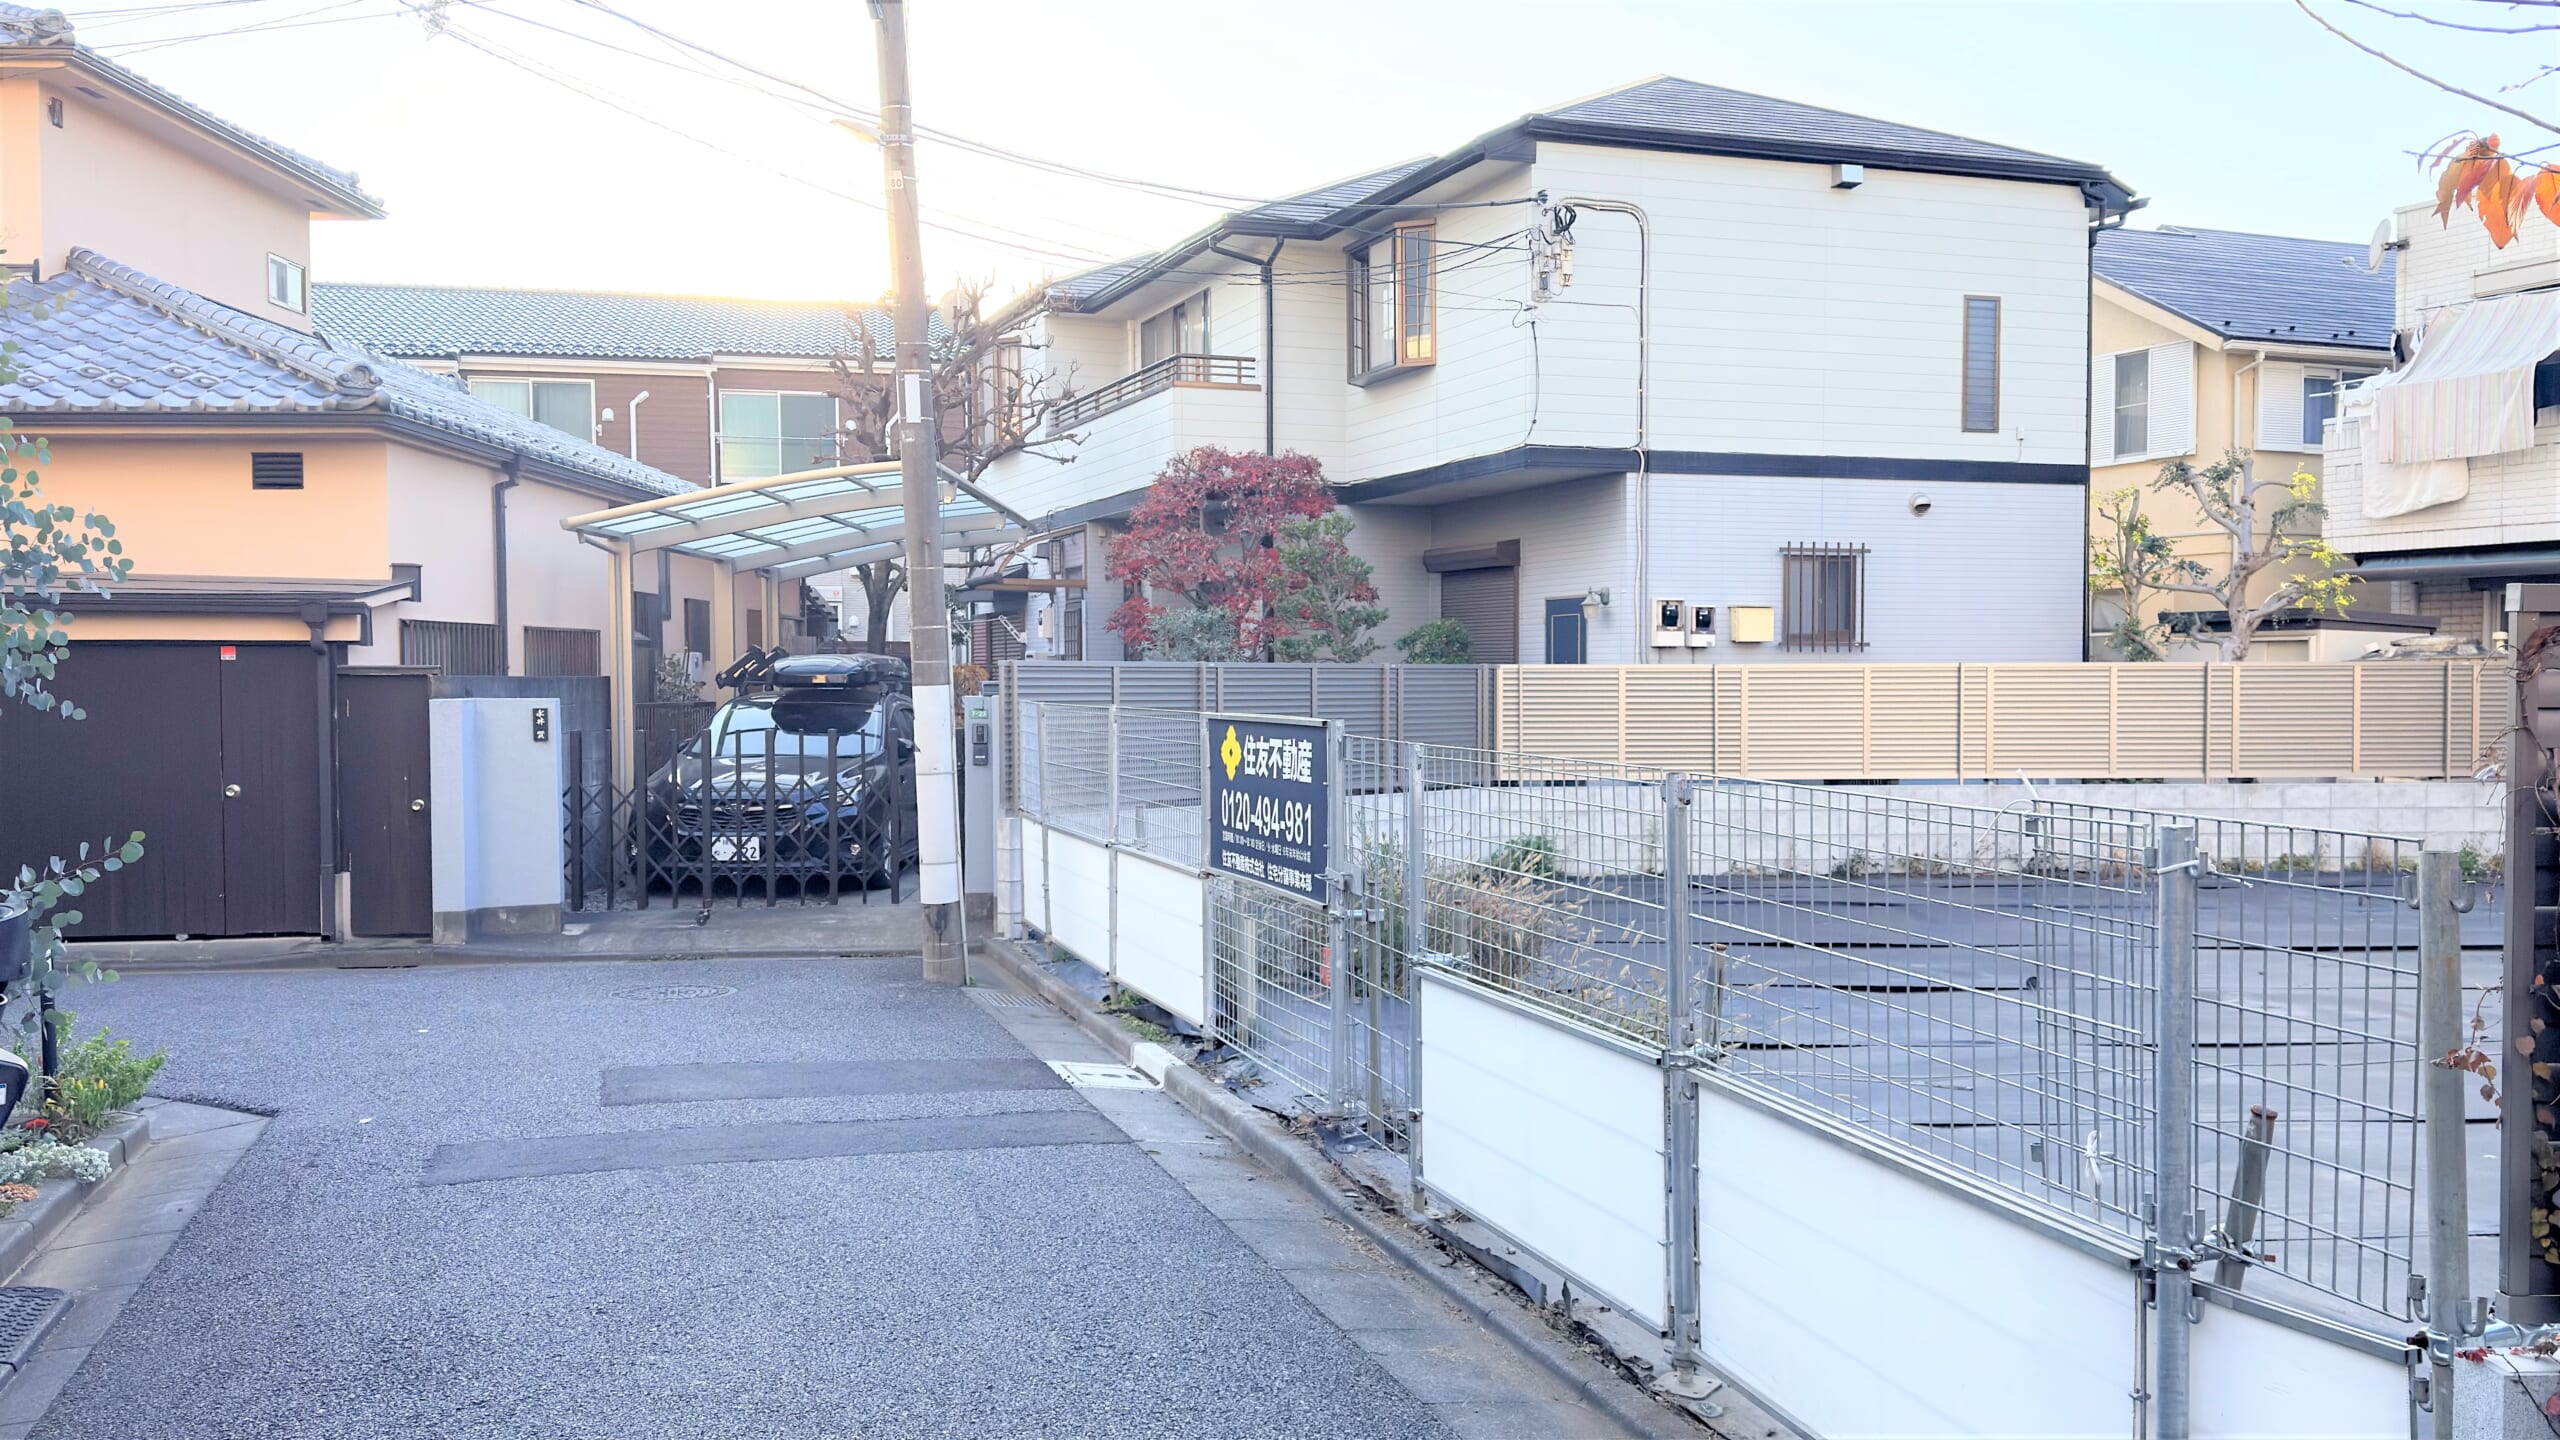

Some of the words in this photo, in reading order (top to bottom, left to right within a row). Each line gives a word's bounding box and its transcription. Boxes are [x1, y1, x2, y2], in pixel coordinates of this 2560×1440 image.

[1243, 734, 1313, 784] 住友不動産
[1221, 788, 1312, 847] 0120-494-981
